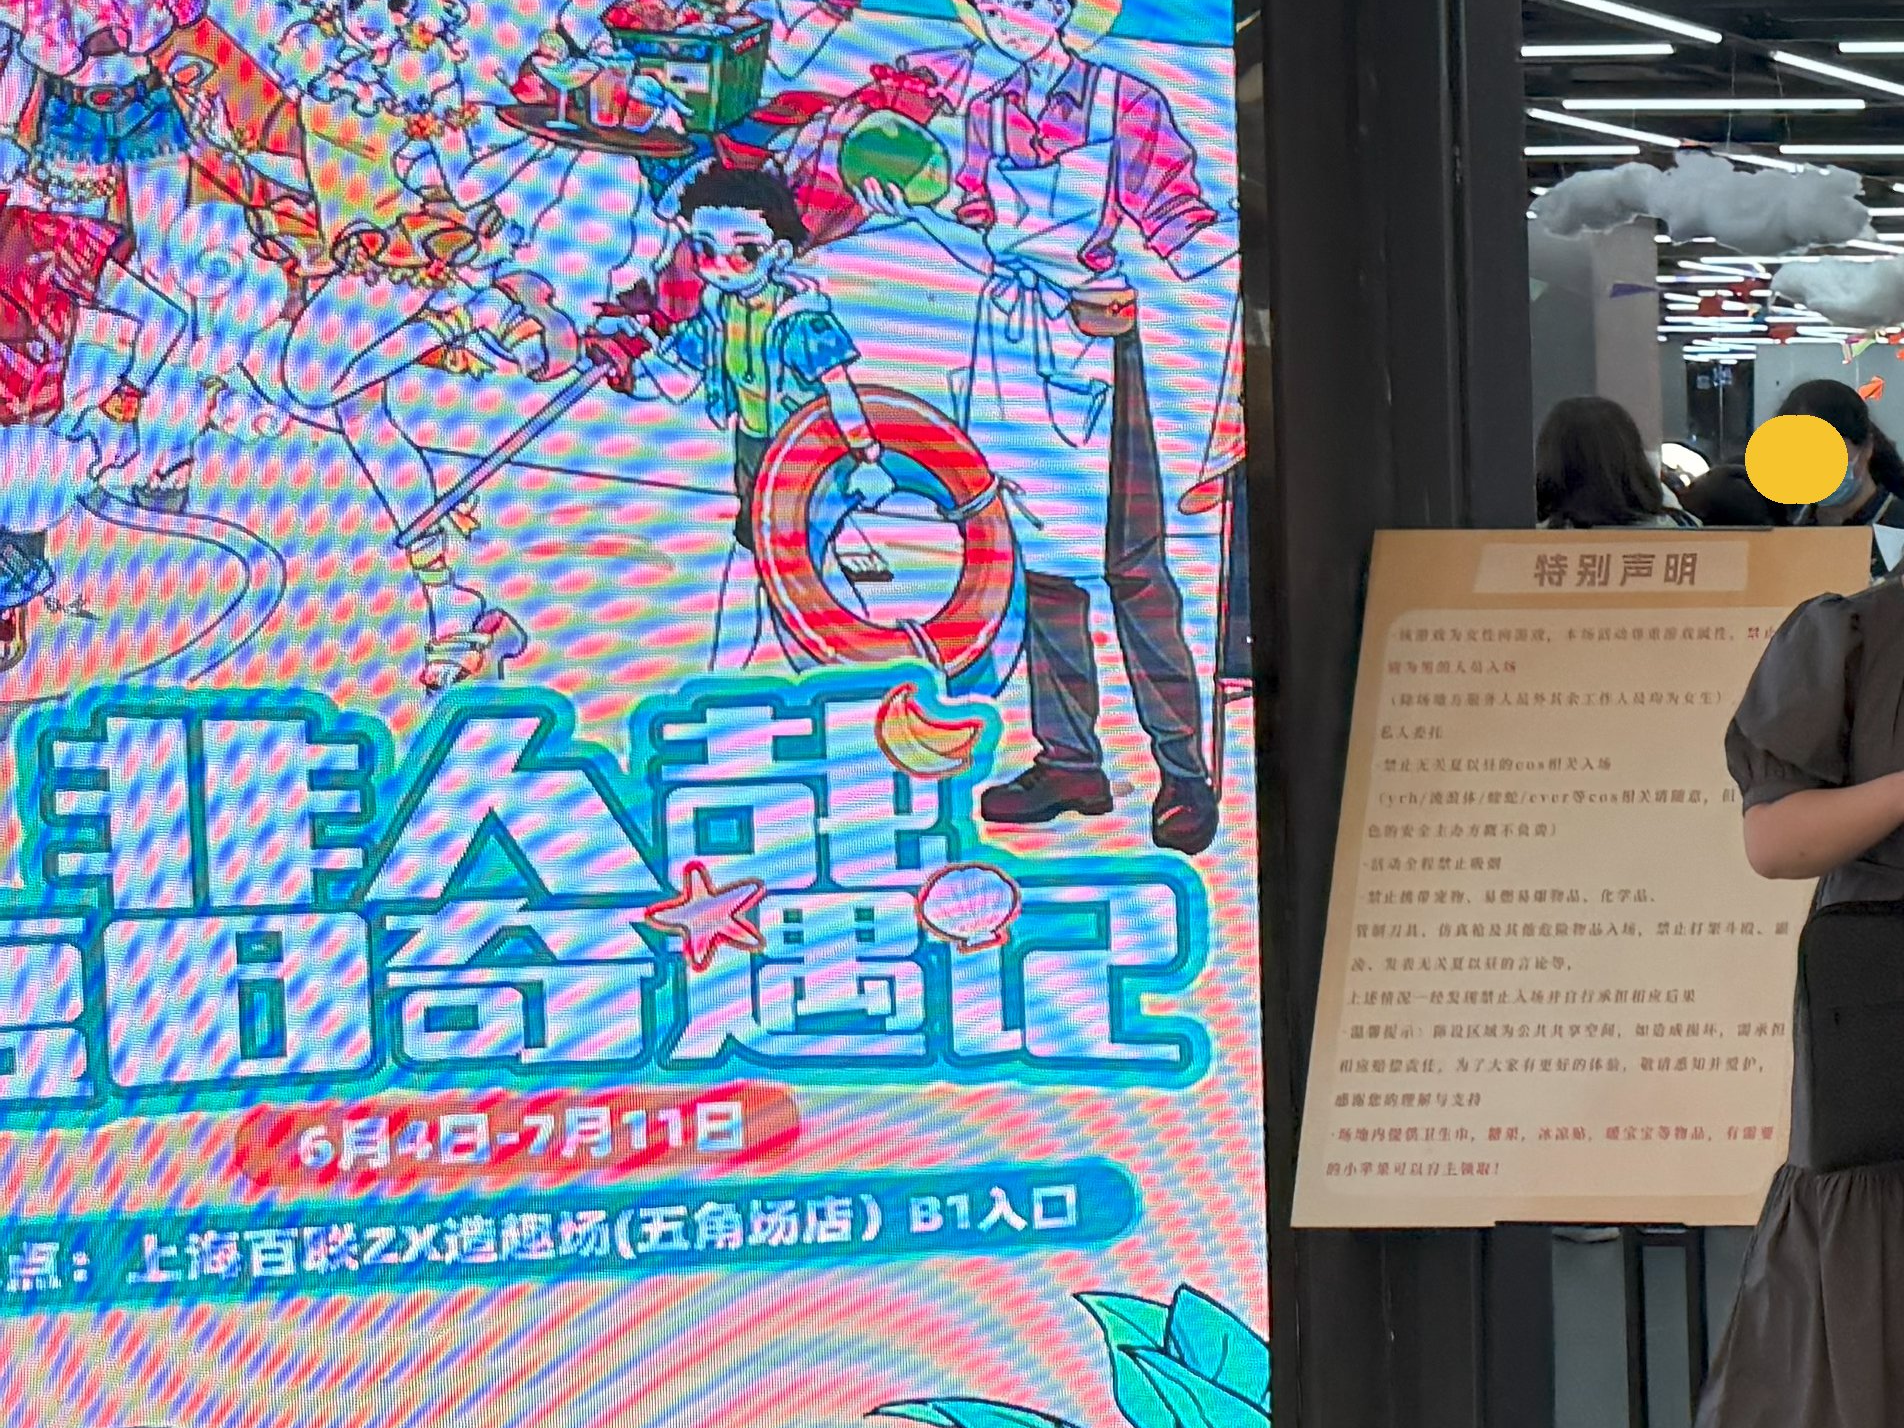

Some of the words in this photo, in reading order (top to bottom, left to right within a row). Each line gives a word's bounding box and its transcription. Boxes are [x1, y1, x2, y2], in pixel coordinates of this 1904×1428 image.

[1533, 552, 1699, 588] 特别声明
[299, 1101, 744, 1172] 6月4日-7月11日
